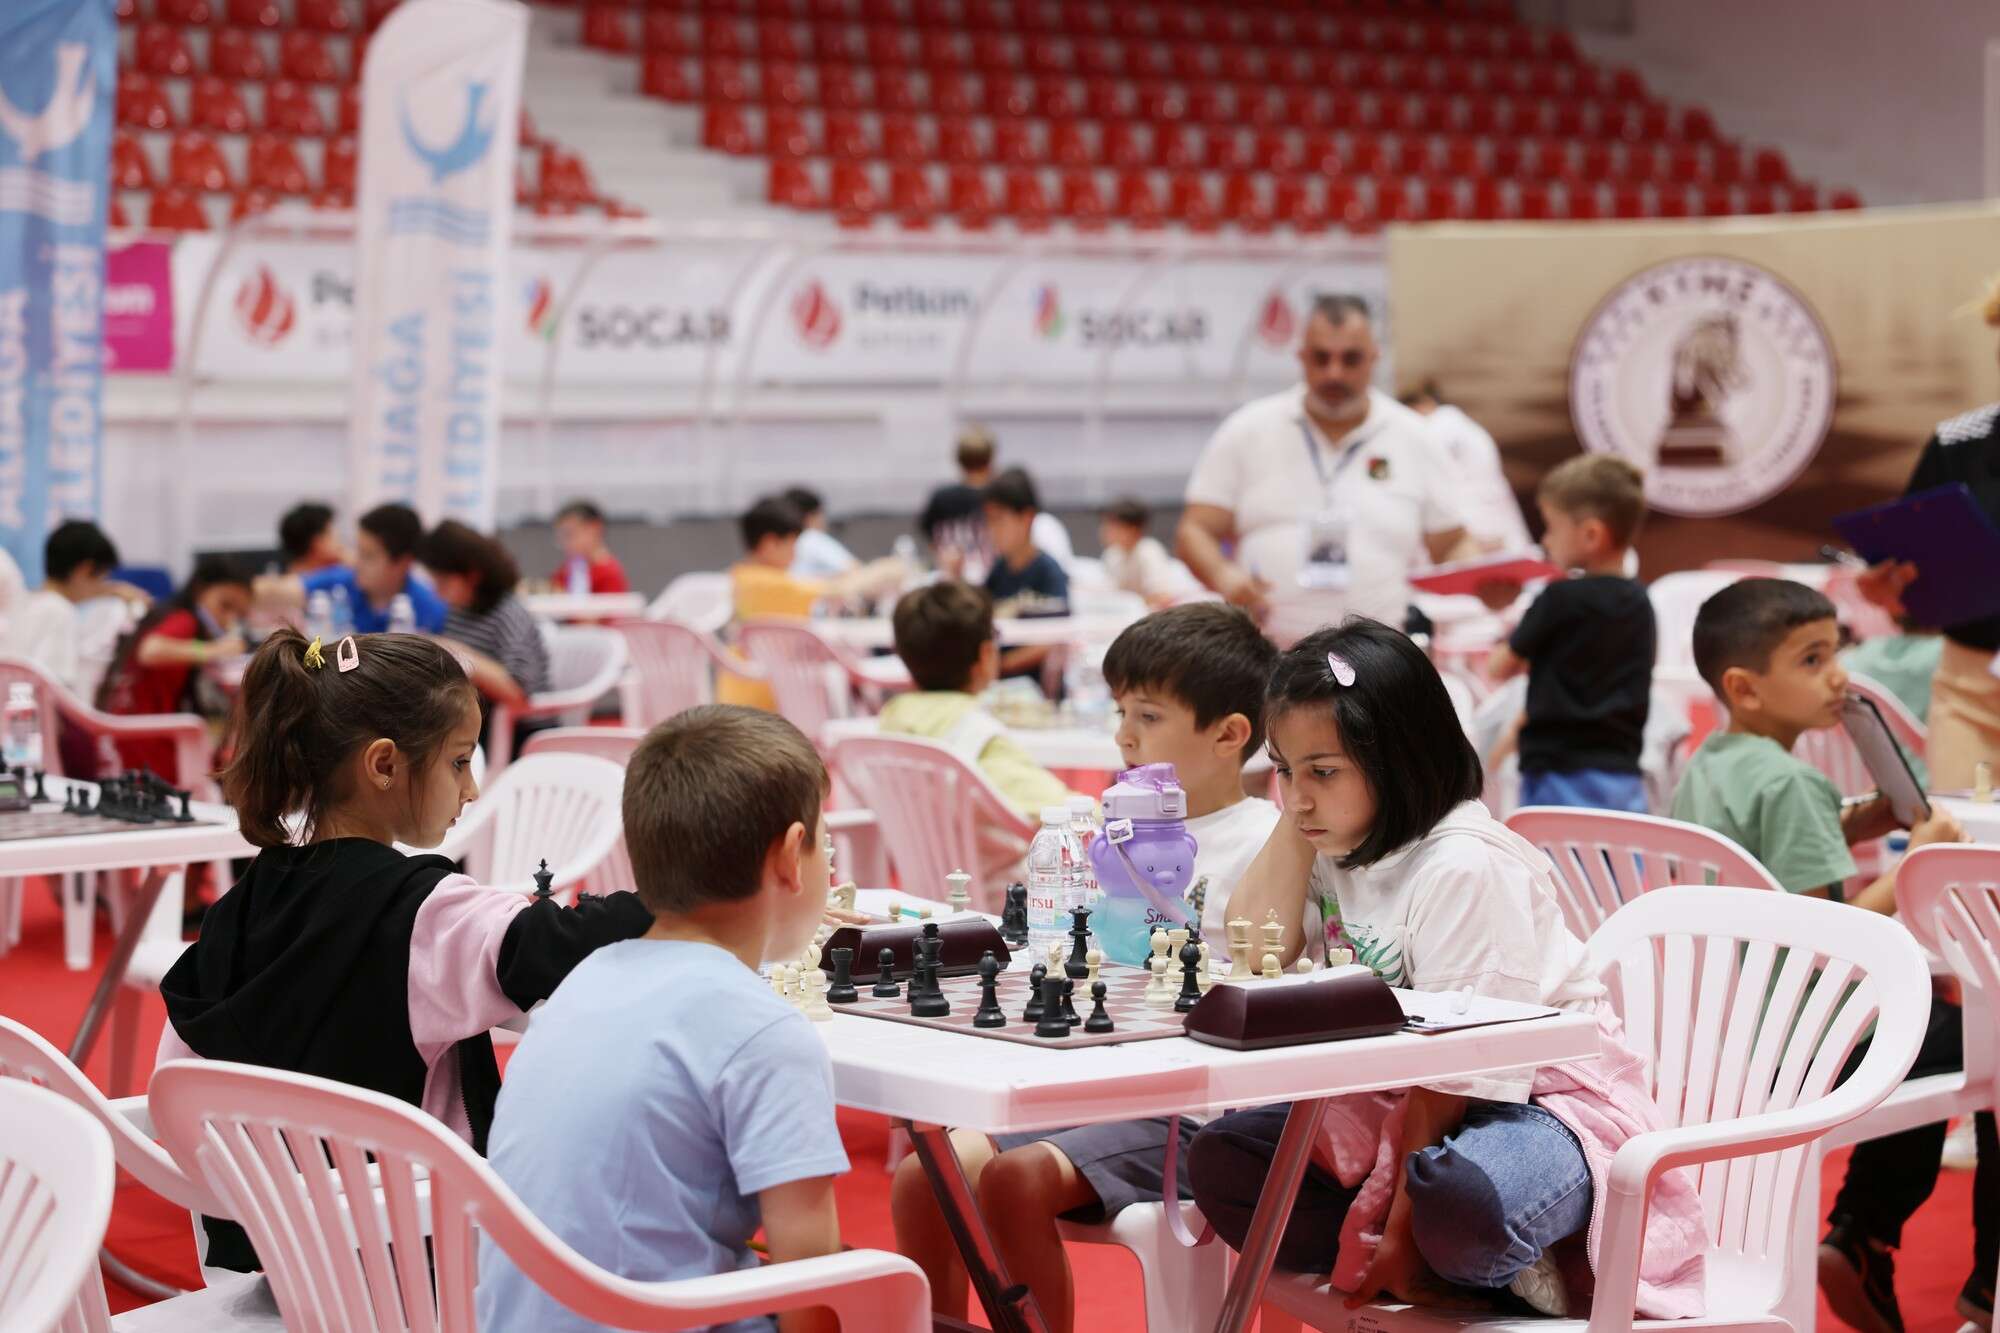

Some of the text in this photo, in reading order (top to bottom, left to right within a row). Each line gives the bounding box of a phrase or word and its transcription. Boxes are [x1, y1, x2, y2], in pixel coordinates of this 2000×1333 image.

[312, 270, 355, 306] Pe
[577, 307, 731, 349] SOCAR
[370, 312, 426, 506] LİAĞA
